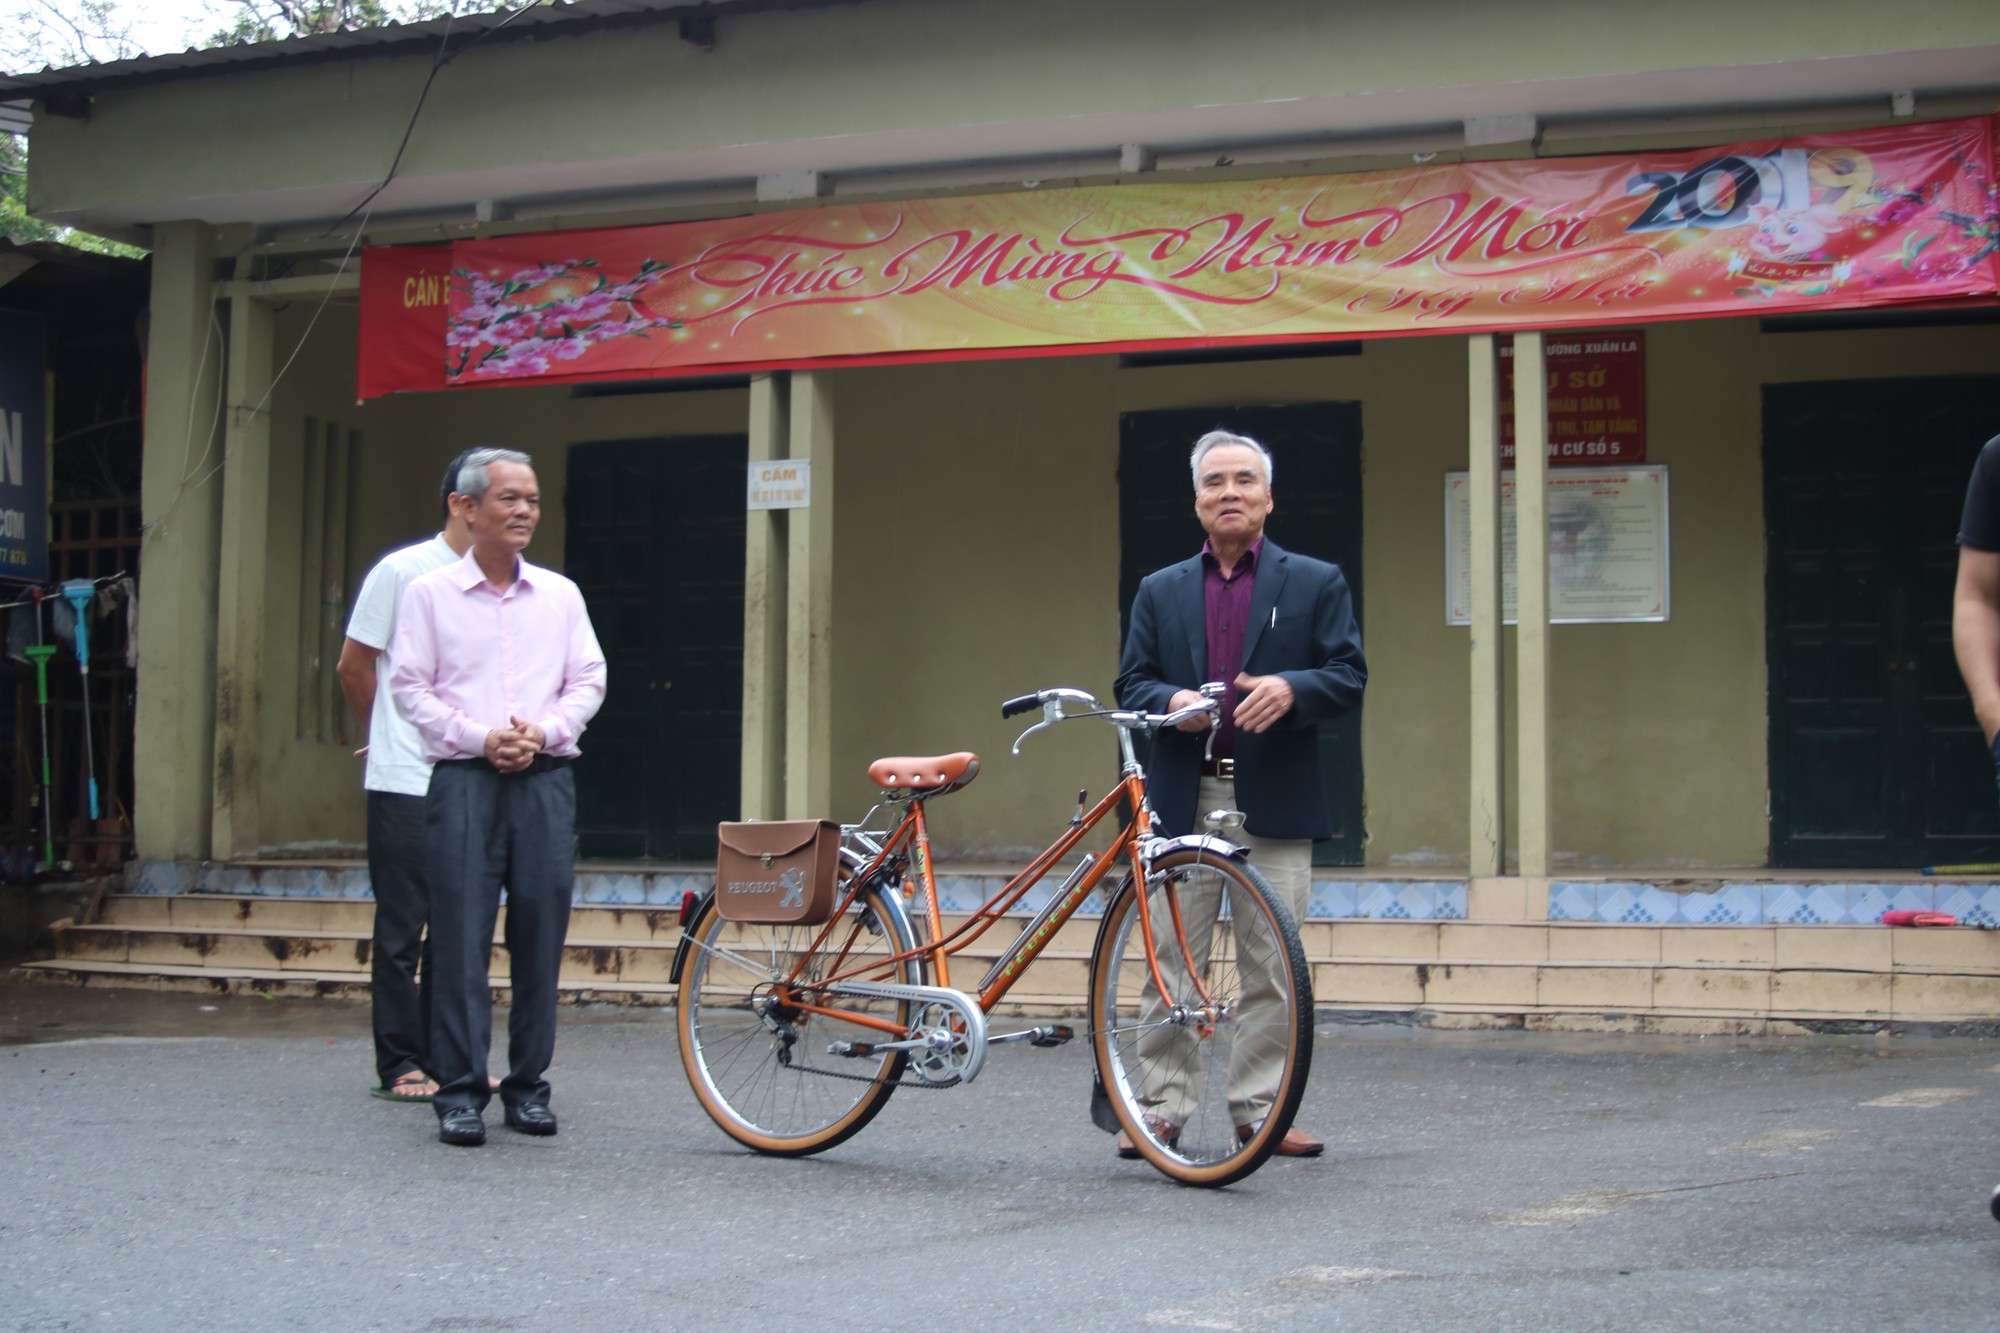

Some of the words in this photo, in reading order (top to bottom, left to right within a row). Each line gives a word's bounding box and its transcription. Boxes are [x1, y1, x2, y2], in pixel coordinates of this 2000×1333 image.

[1625, 148, 1874, 233] 2019
[881, 230, 1125, 301] Mừng
[1130, 212, 1359, 288] Năm
[1358, 192, 1600, 269] Mới
[404, 268, 439, 308] CÁN
[1622, 341, 1637, 352] LA
[1562, 441, 1586, 455] CƯ
[1587, 435, 1607, 455] SỐ
[1611, 442, 1620, 454] 5
[728, 881, 777, 894] PEUGEOT
[1005, 886, 1083, 977] PEUGEOT
